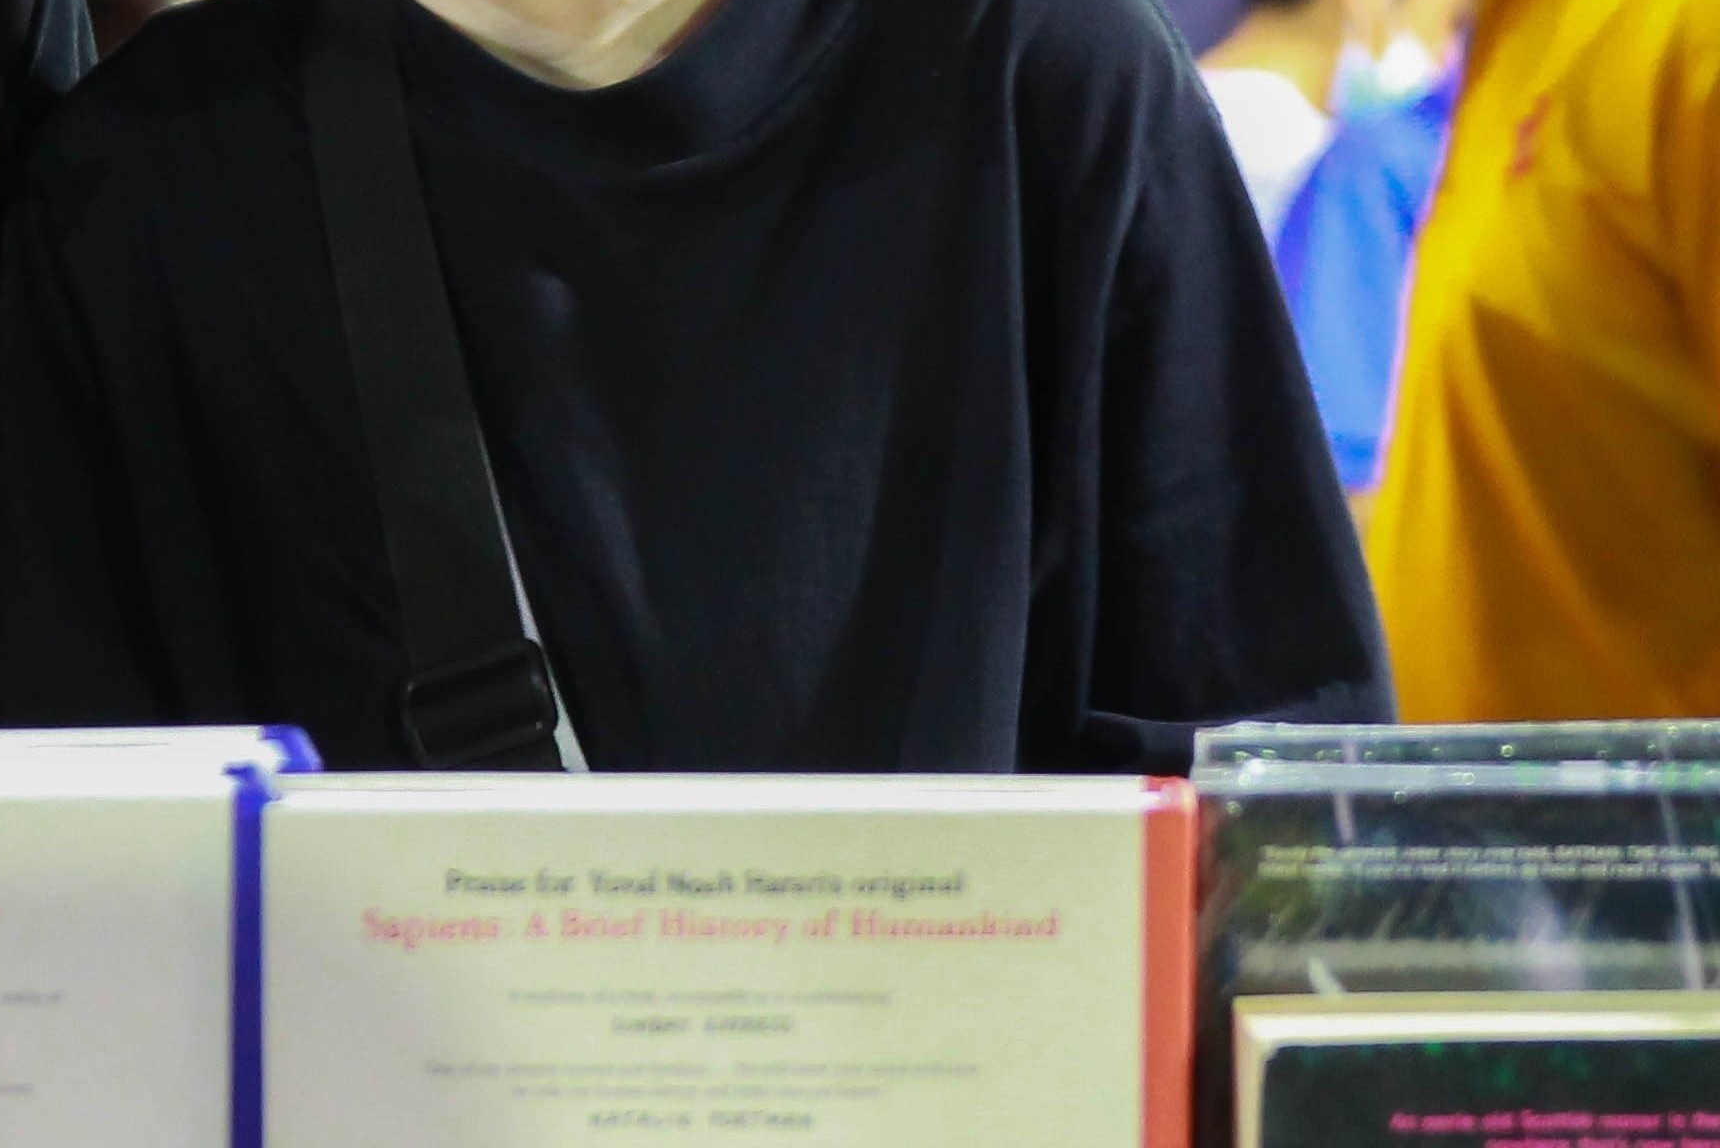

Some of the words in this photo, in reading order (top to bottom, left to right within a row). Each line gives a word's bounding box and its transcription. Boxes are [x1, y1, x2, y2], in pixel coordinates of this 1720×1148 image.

[535, 867, 574, 893] for
[850, 869, 967, 902] original
[524, 910, 550, 939] A
[560, 907, 647, 939] Brief
[660, 907, 791, 947] History
[802, 906, 839, 938] of
[850, 906, 1061, 939] Humankind
